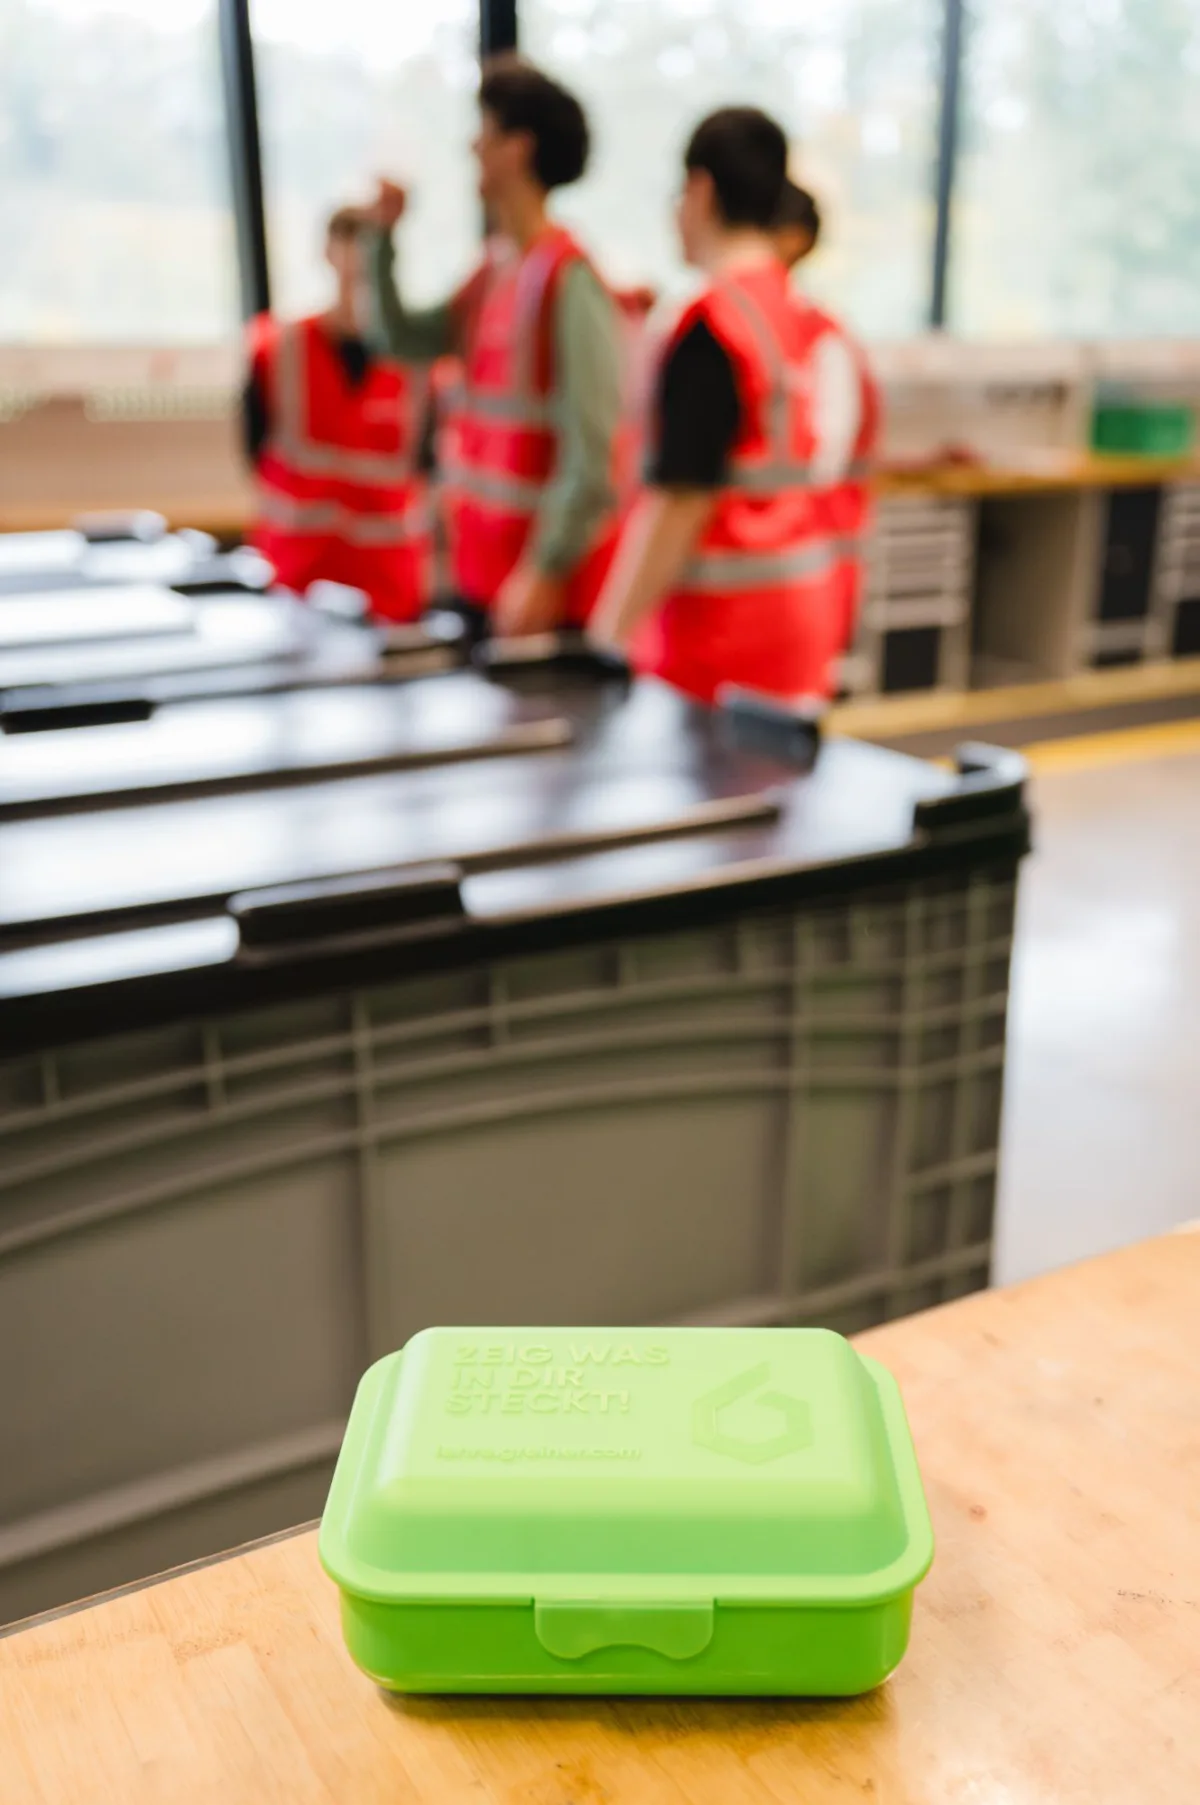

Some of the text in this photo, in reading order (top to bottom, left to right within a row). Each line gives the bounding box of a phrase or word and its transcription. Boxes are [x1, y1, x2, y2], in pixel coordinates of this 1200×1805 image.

[453, 1342, 670, 1367] ZEIG WAS
[450, 1367, 585, 1391] IN DIR
[444, 1389, 632, 1415] STECKT!
